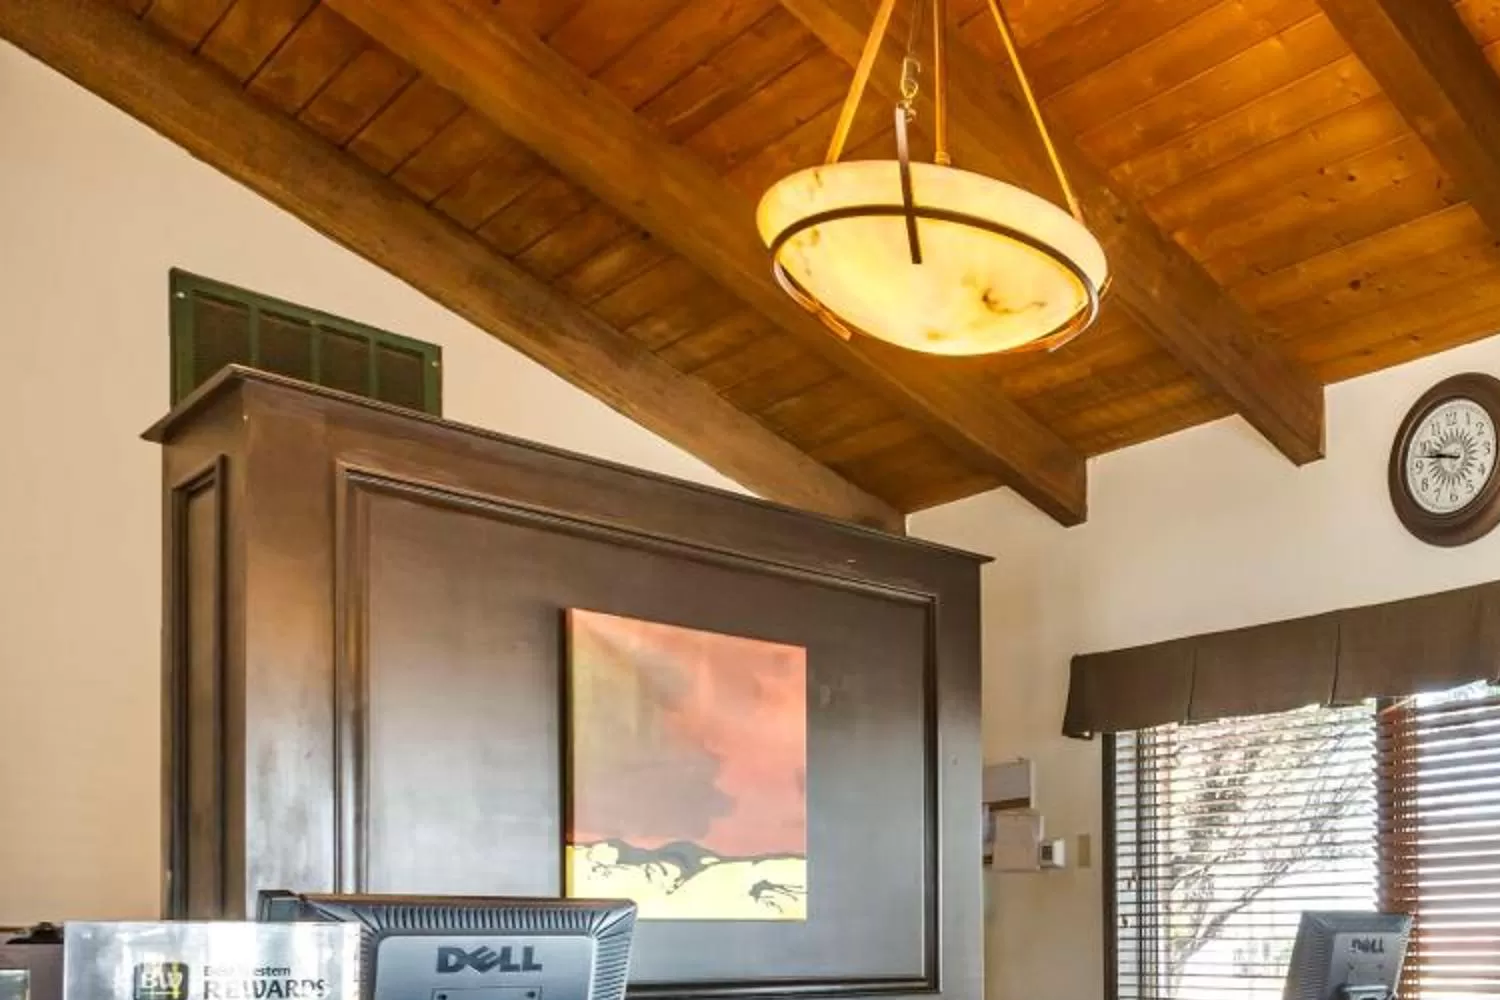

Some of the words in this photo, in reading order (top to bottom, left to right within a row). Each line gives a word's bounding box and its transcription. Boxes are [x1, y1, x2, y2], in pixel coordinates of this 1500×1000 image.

[1415, 459, 1424, 475] 9
[436, 946, 543, 973] DELL
[238, 965, 292, 977] estern
[203, 978, 327, 1000] REWARDS
